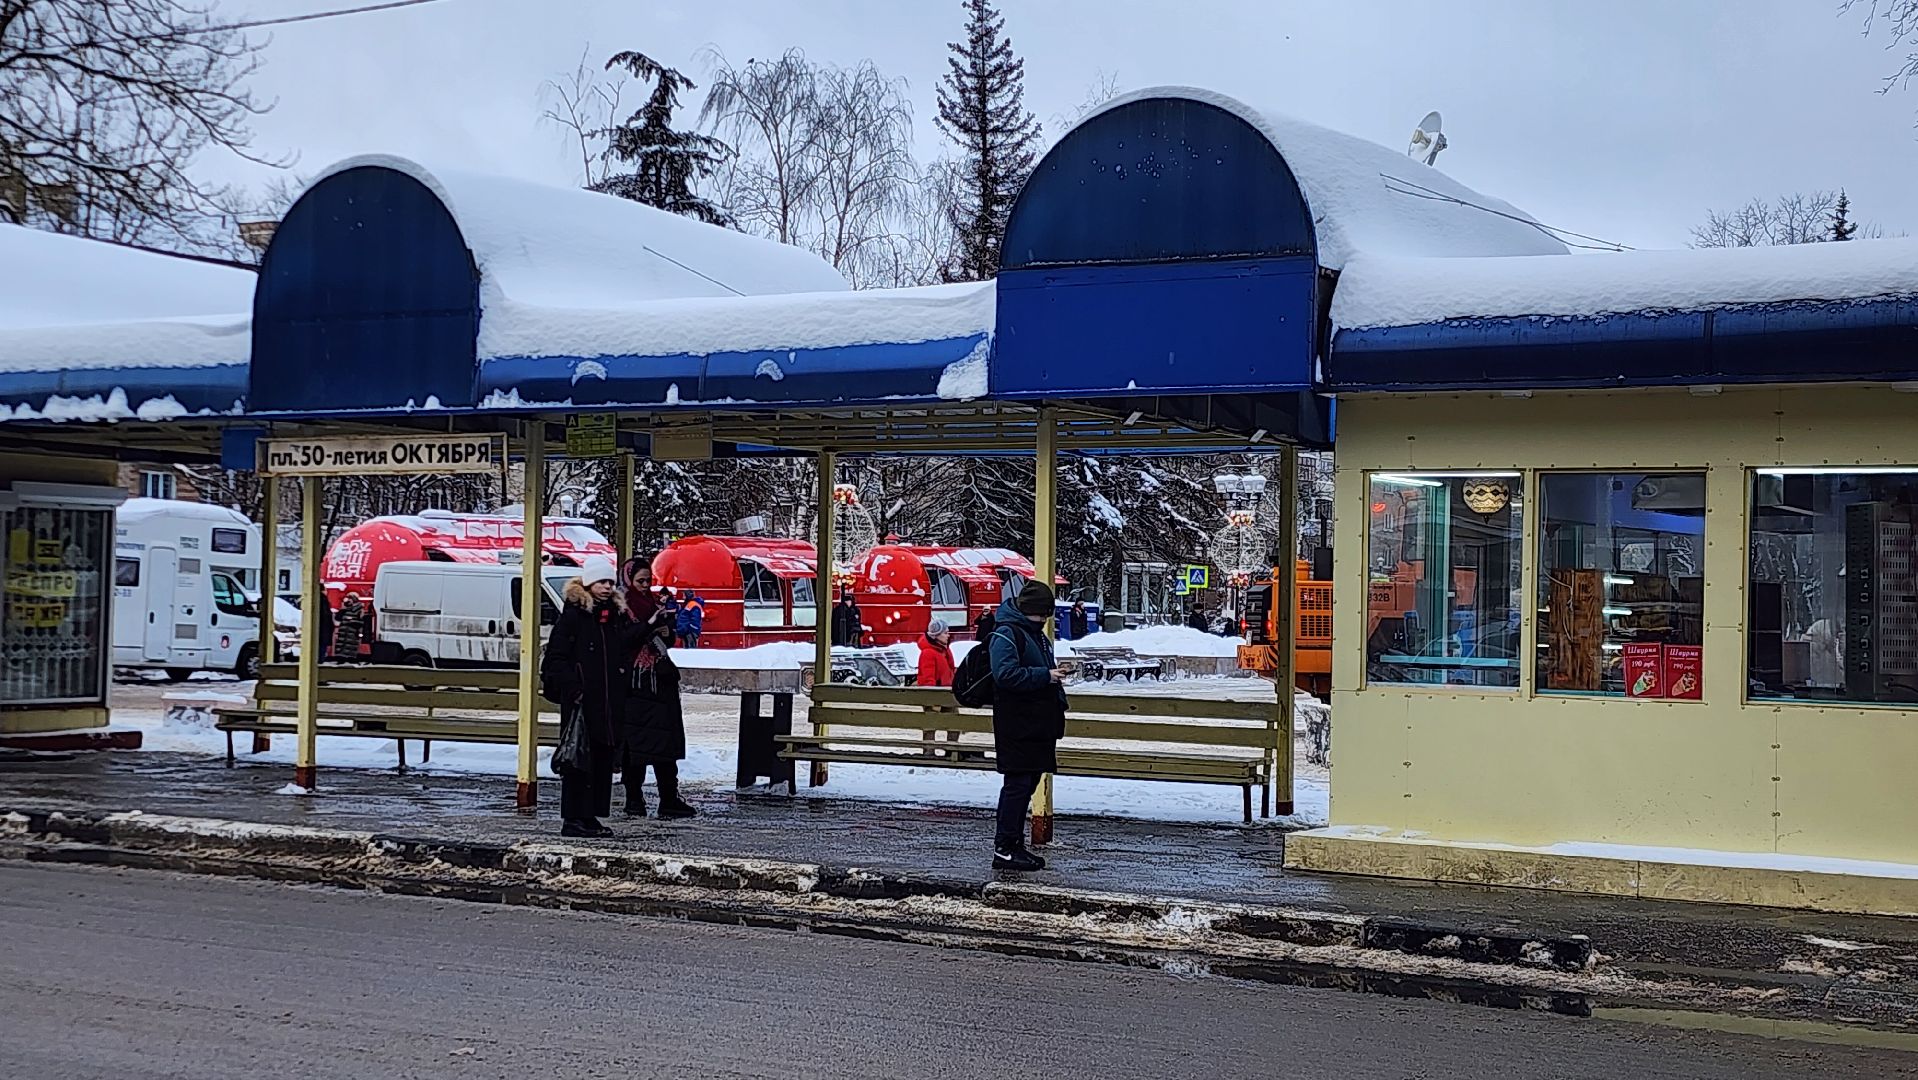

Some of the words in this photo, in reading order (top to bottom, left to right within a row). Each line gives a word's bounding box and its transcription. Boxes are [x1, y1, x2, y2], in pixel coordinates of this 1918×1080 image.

[271, 452, 298, 466] пл.
[300, 445, 388, 465] 50-летия
[391, 442, 489, 464] ОКТЯБРЯ
[334, 539, 373, 554] ебу
[326, 564, 361, 578] ная
[1627, 646, 1657, 654] Шаурма
[1669, 648, 1699, 657] Шаурма
[1631, 660, 1643, 668] 190
